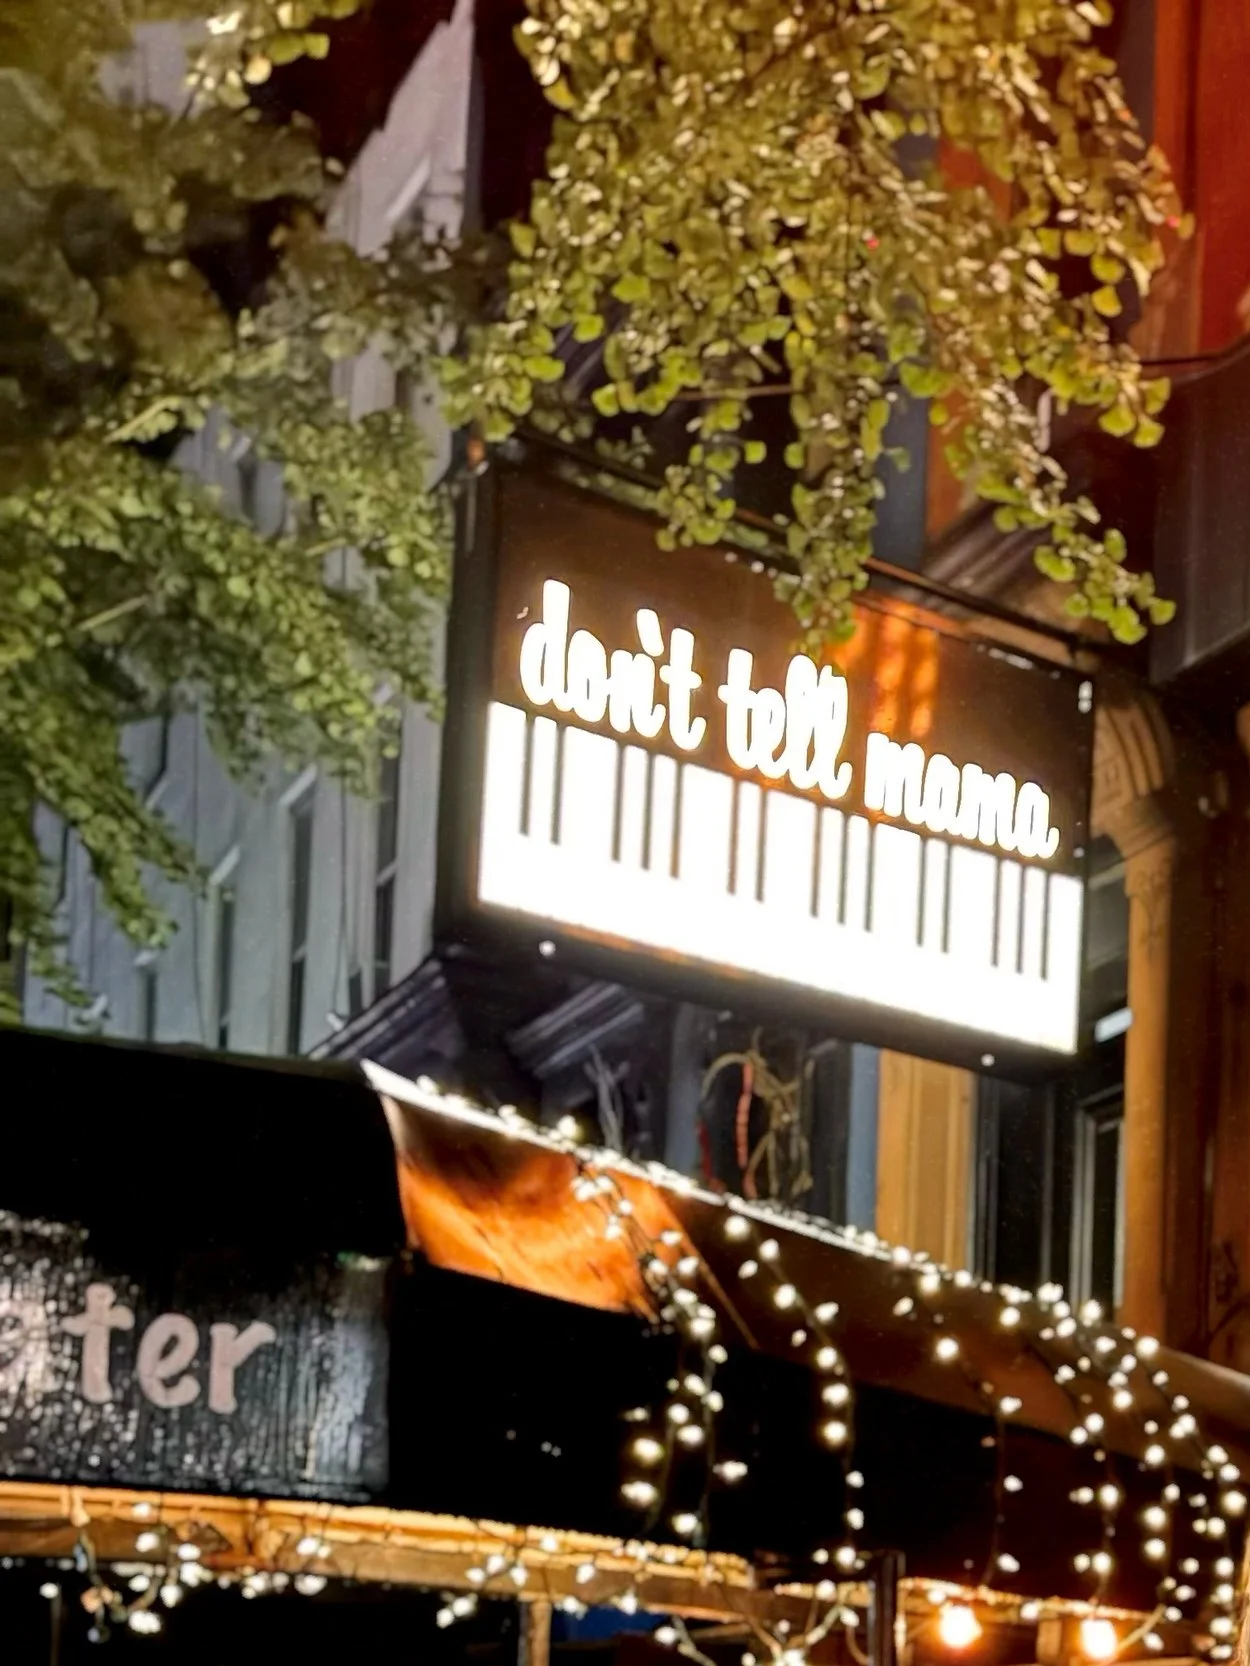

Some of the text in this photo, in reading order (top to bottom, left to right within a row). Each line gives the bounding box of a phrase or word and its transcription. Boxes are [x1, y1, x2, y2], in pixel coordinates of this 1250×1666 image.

[519, 578, 1060, 860] don't tell mama
